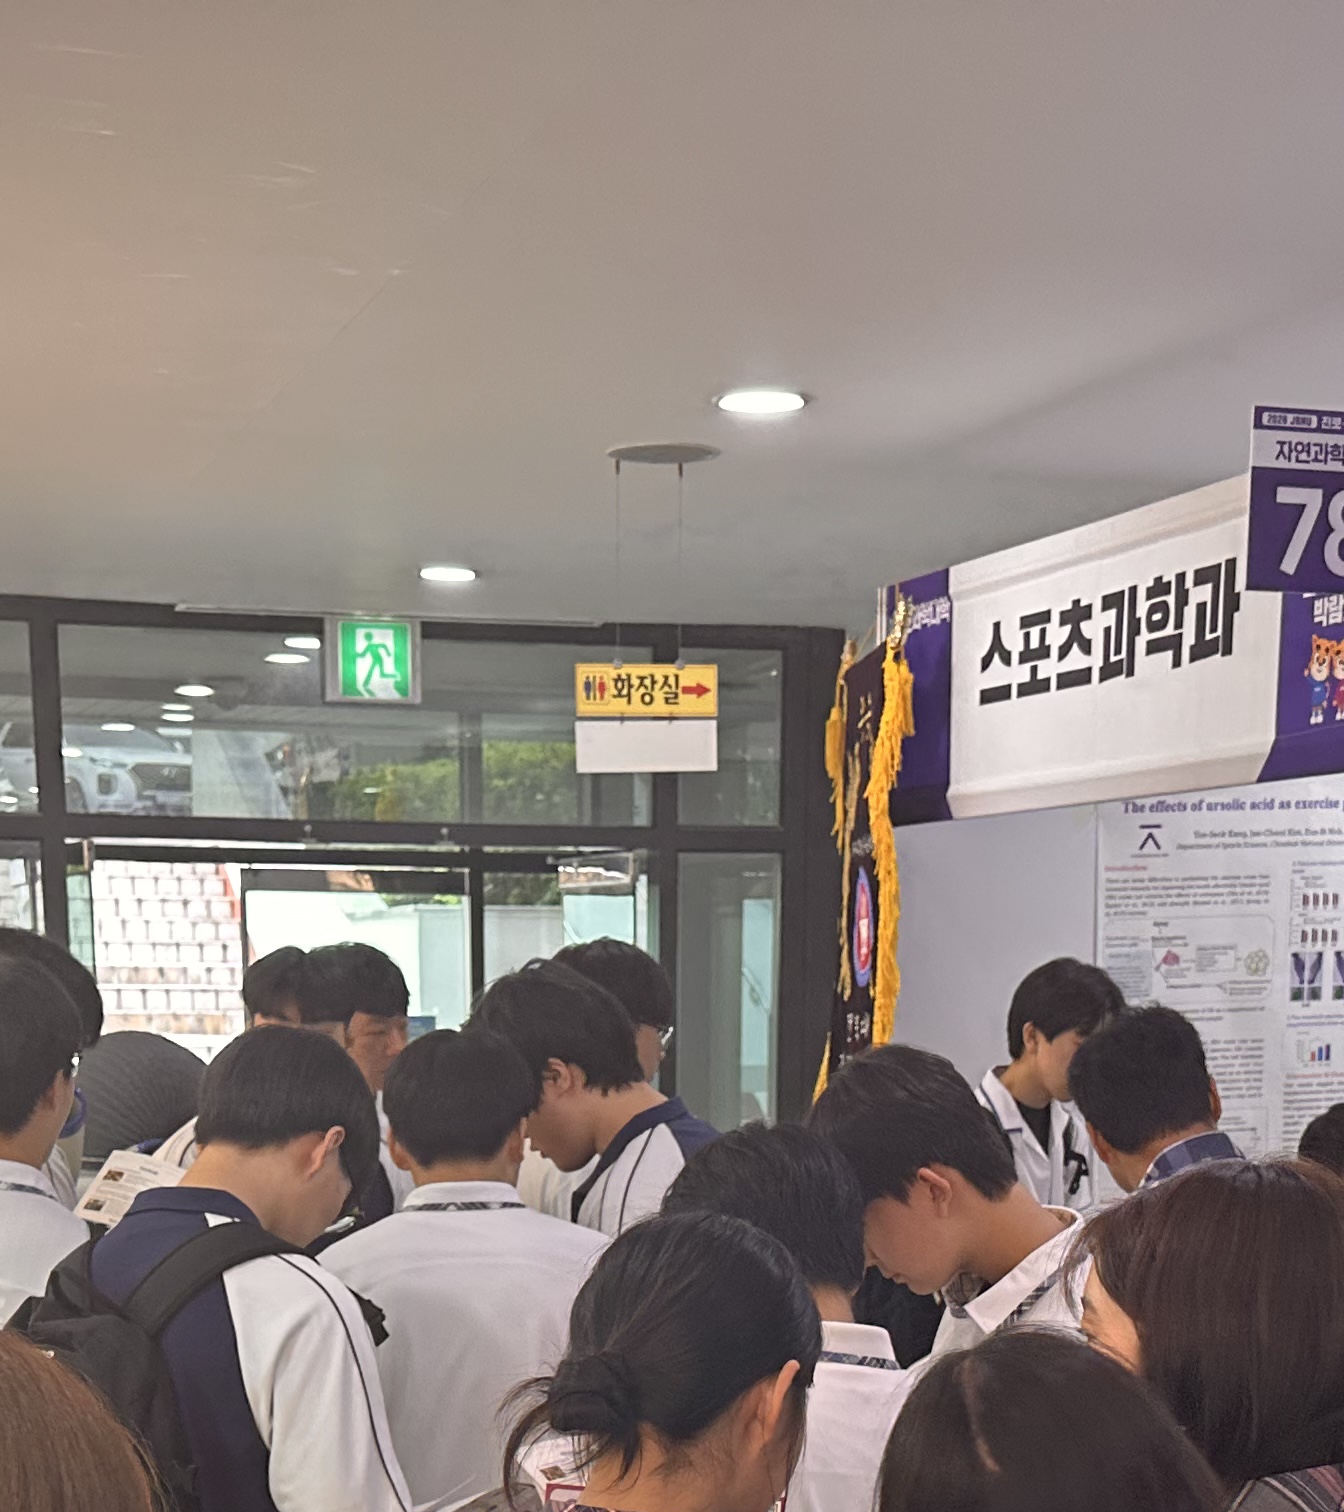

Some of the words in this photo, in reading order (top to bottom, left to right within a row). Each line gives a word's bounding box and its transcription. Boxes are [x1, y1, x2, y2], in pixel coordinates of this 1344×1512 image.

[978, 556, 1241, 707] 스포츠과학과
[612, 673, 679, 706] 화장실
[1123, 801, 1146, 814] The
[1149, 800, 1187, 813] effects
[1190, 799, 1204, 812] of
[1250, 797, 1275, 810] acid
[1278, 800, 1292, 809] as
[1294, 796, 1340, 809] exercise
